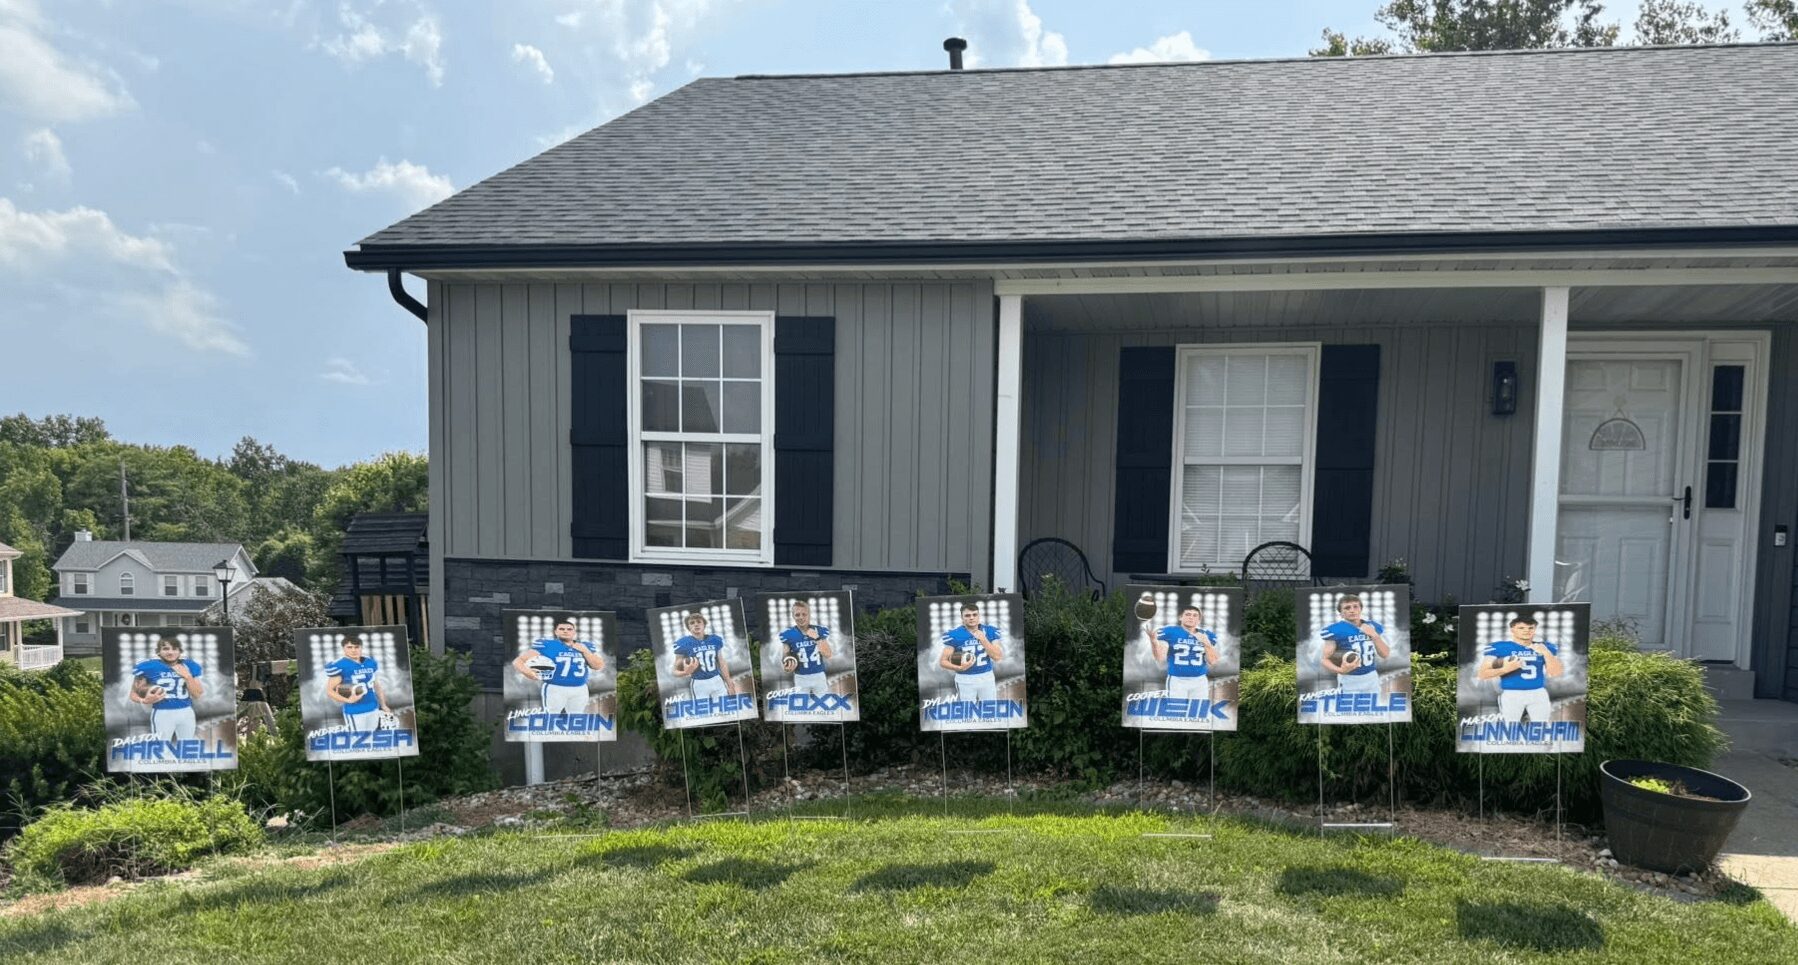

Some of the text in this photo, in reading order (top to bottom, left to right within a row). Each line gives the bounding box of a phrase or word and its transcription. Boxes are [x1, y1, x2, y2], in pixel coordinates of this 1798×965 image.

[692, 644, 716, 653] EAGLES
[798, 646, 821, 669] 44
[1173, 643, 1205, 666] 23
[555, 656, 586, 677] 73
[696, 650, 717, 672] 10
[1520, 656, 1538, 680] 5
[664, 693, 685, 706] MAX
[766, 686, 802, 700] COOPER
[768, 693, 854, 711] FOXX
[922, 693, 959, 709] DYLAN
[1126, 689, 1170, 702] COOPER
[1300, 692, 1407, 713] STEELE
[665, 692, 754, 720] DREHER
[924, 699, 1024, 721] ROBINSON
[1126, 698, 1231, 720] WEIK
[508, 713, 614, 732] CORBIN
[1460, 713, 1504, 727] MASON
[113, 732, 162, 748] DALTON
[307, 724, 350, 740] ANDREW
[310, 729, 413, 750] BOZSA
[1461, 721, 1580, 741] CUNNINGHAM
[111, 739, 233, 759] HARVELL
